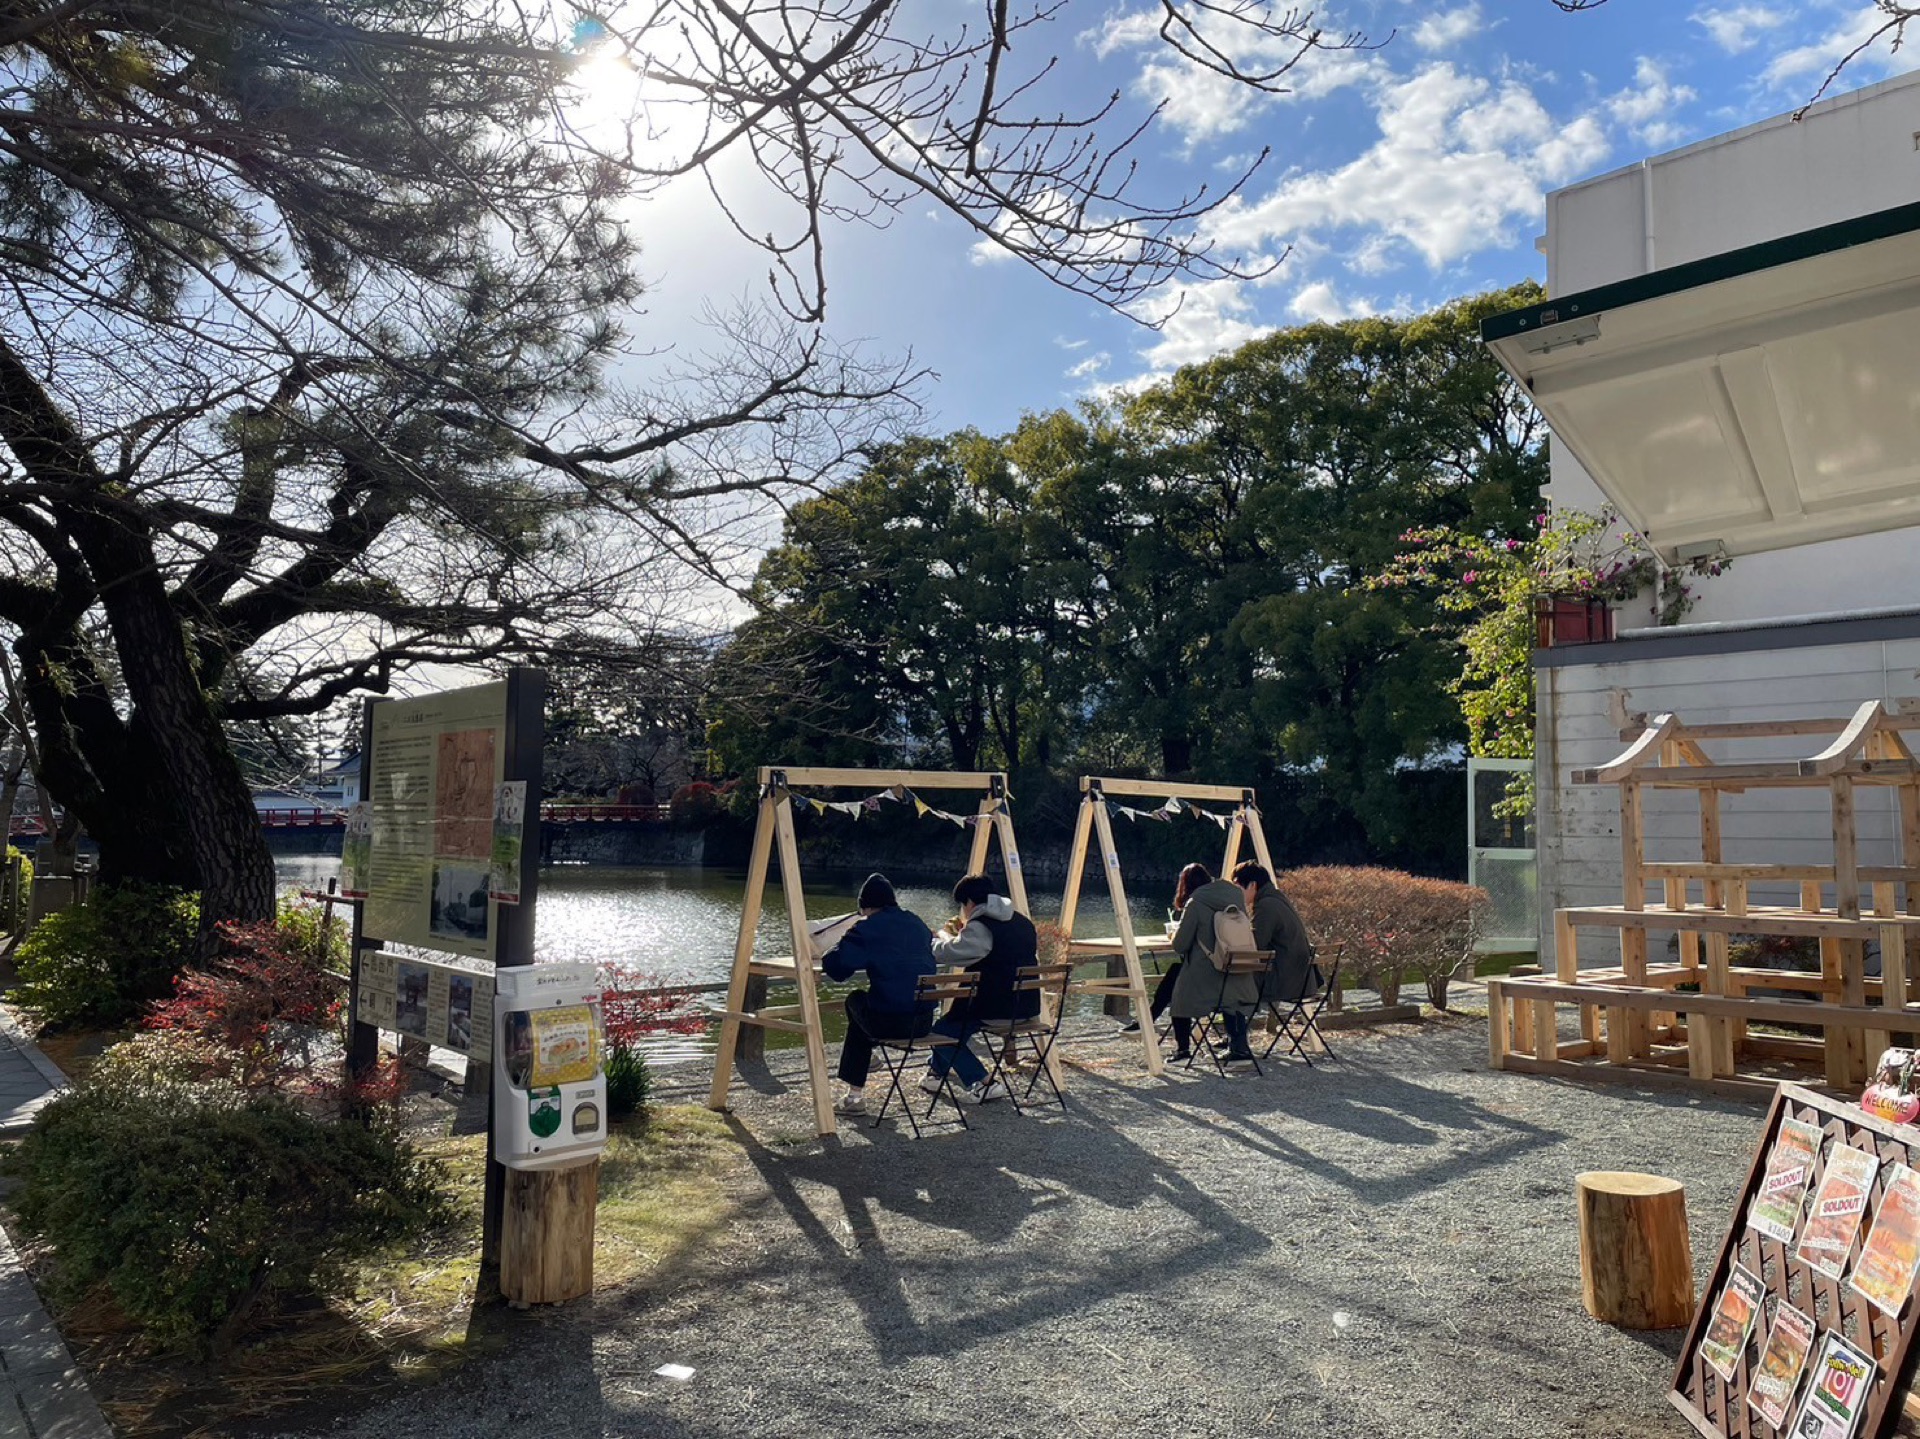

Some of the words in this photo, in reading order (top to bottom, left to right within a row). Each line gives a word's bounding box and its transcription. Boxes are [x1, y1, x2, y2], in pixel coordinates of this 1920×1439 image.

[1865, 1094, 1910, 1114] WELCOME
[1768, 1170, 1803, 1190] SOLDOUT
[1822, 1197, 1861, 1213] SOLDOUT
